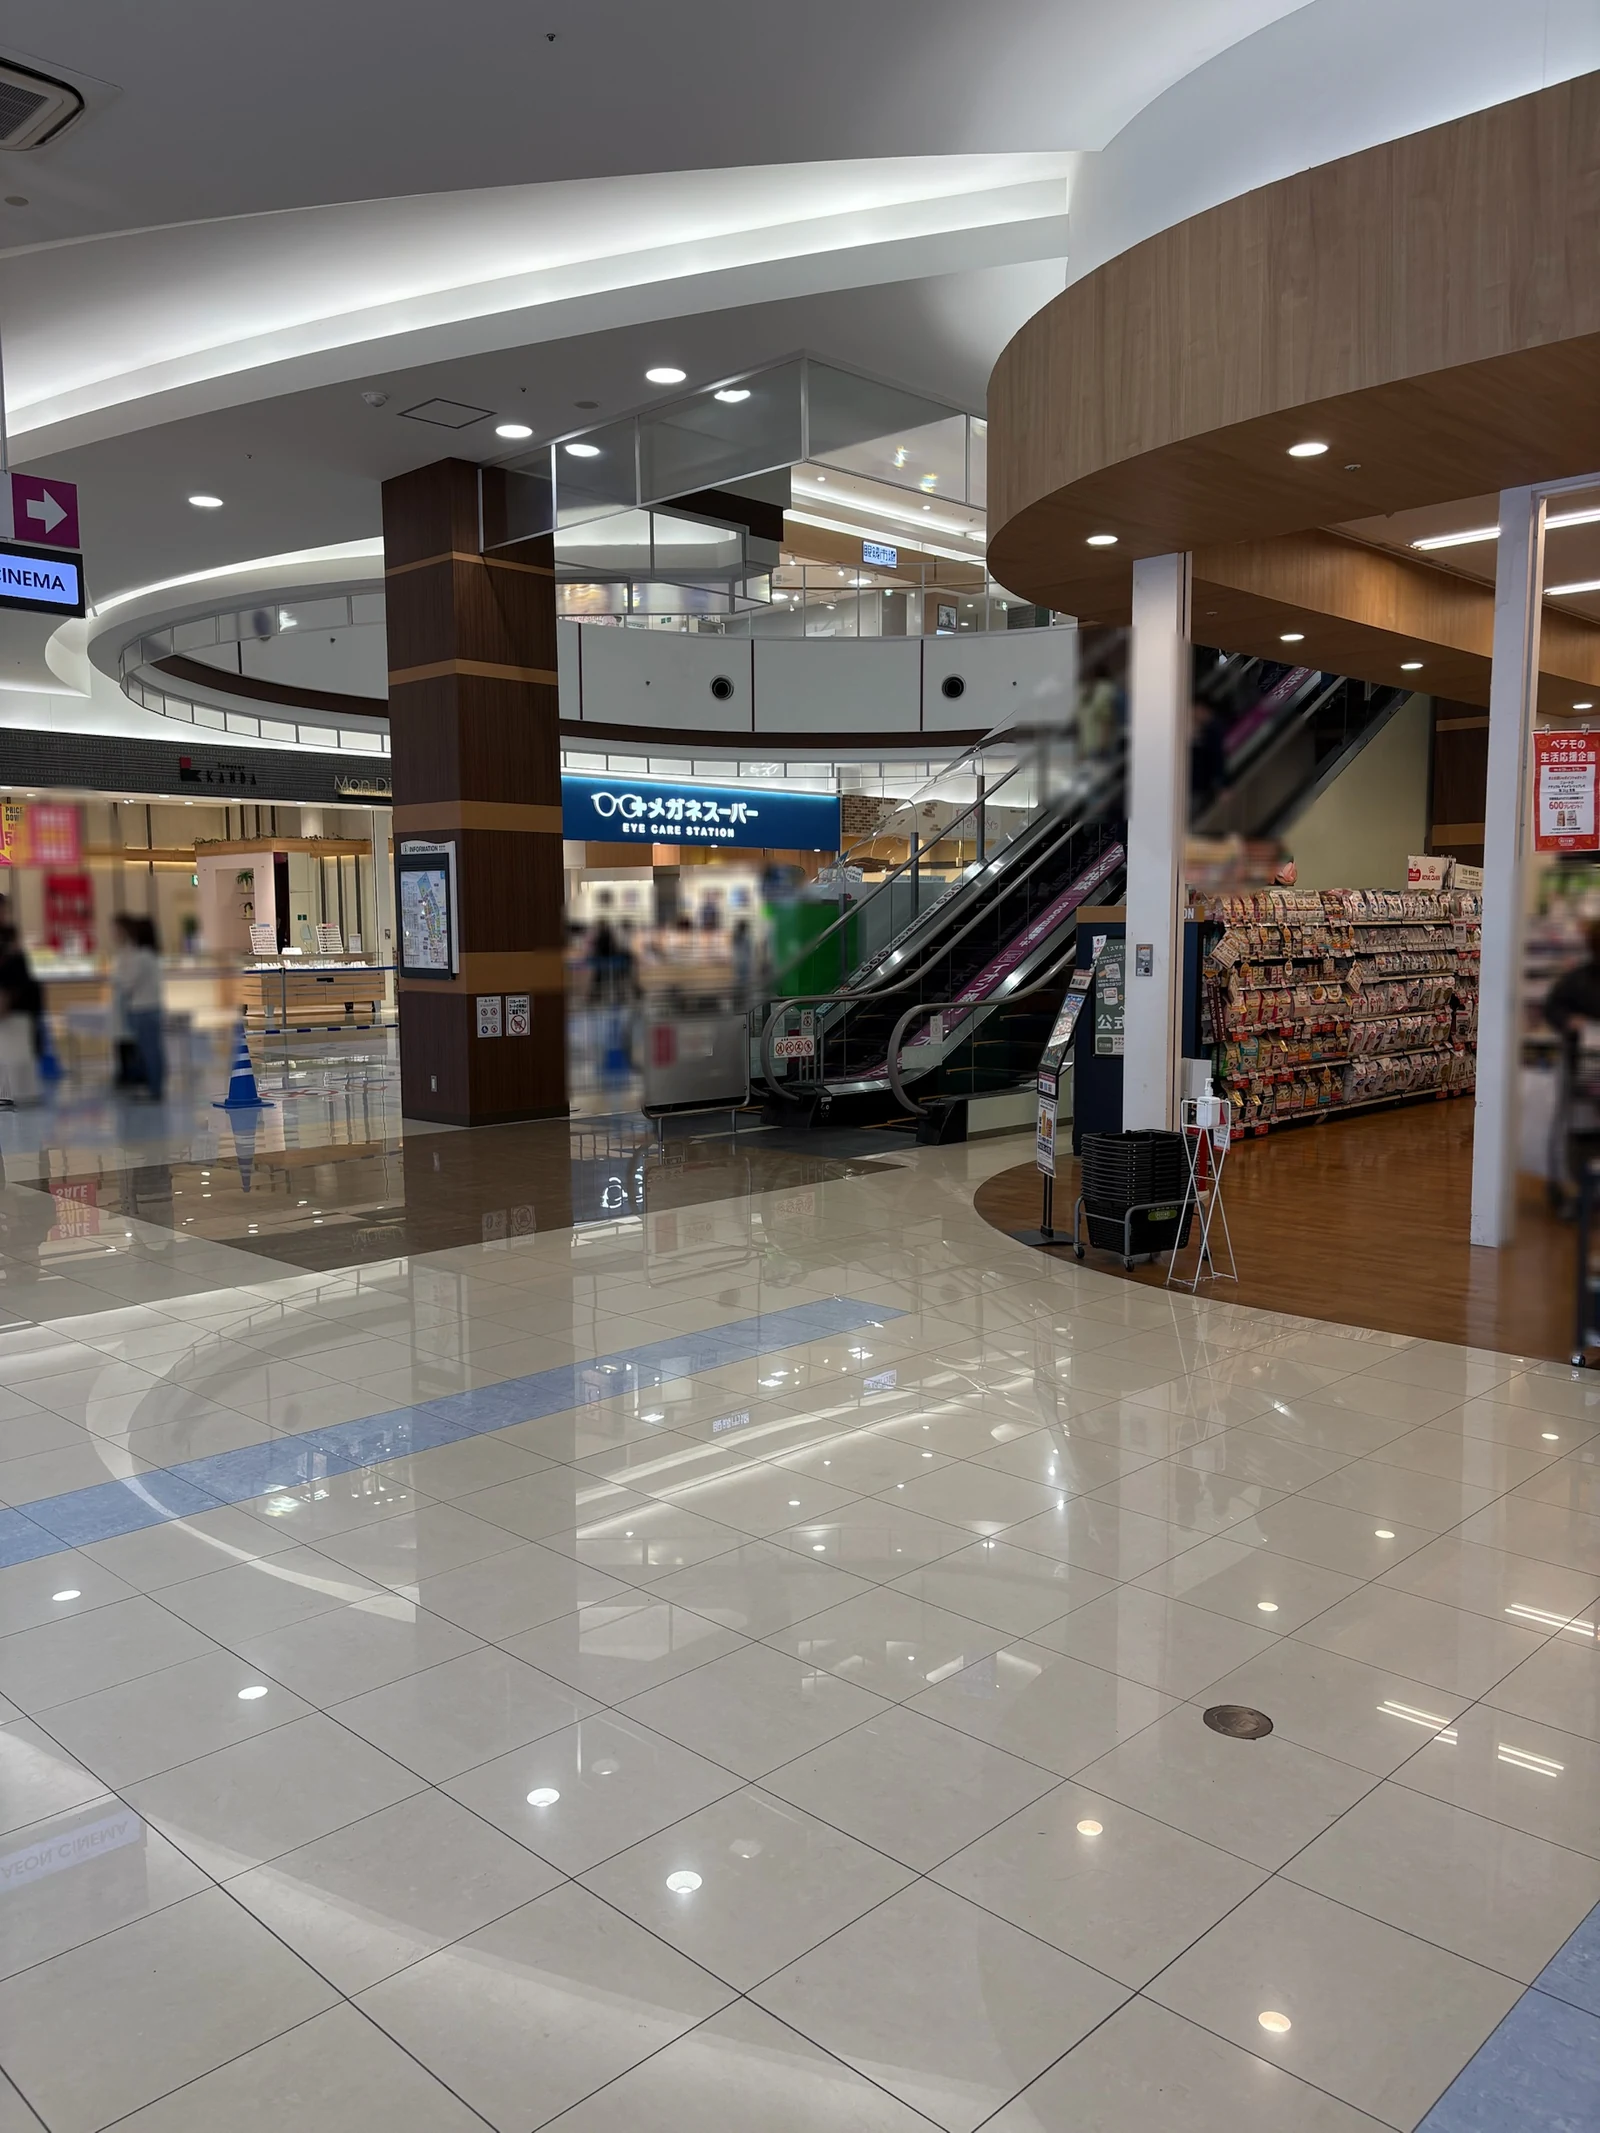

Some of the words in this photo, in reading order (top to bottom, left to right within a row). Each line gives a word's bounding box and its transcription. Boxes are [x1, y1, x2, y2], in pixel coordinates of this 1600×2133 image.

[0, 567, 66, 592] INEMA
[1551, 739, 1586, 749] ペテモの
[1540, 751, 1596, 763] 生活応援企画
[206, 769, 257, 785] KANDA
[334, 775, 370, 791] Mon
[647, 797, 759, 824] メガネスーパー
[1549, 801, 1564, 810] 600
[622, 822, 646, 833] EYE
[651, 824, 681, 836] CARE
[686, 826, 735, 838] STATION
[409, 845, 438, 853] INFORMATION
